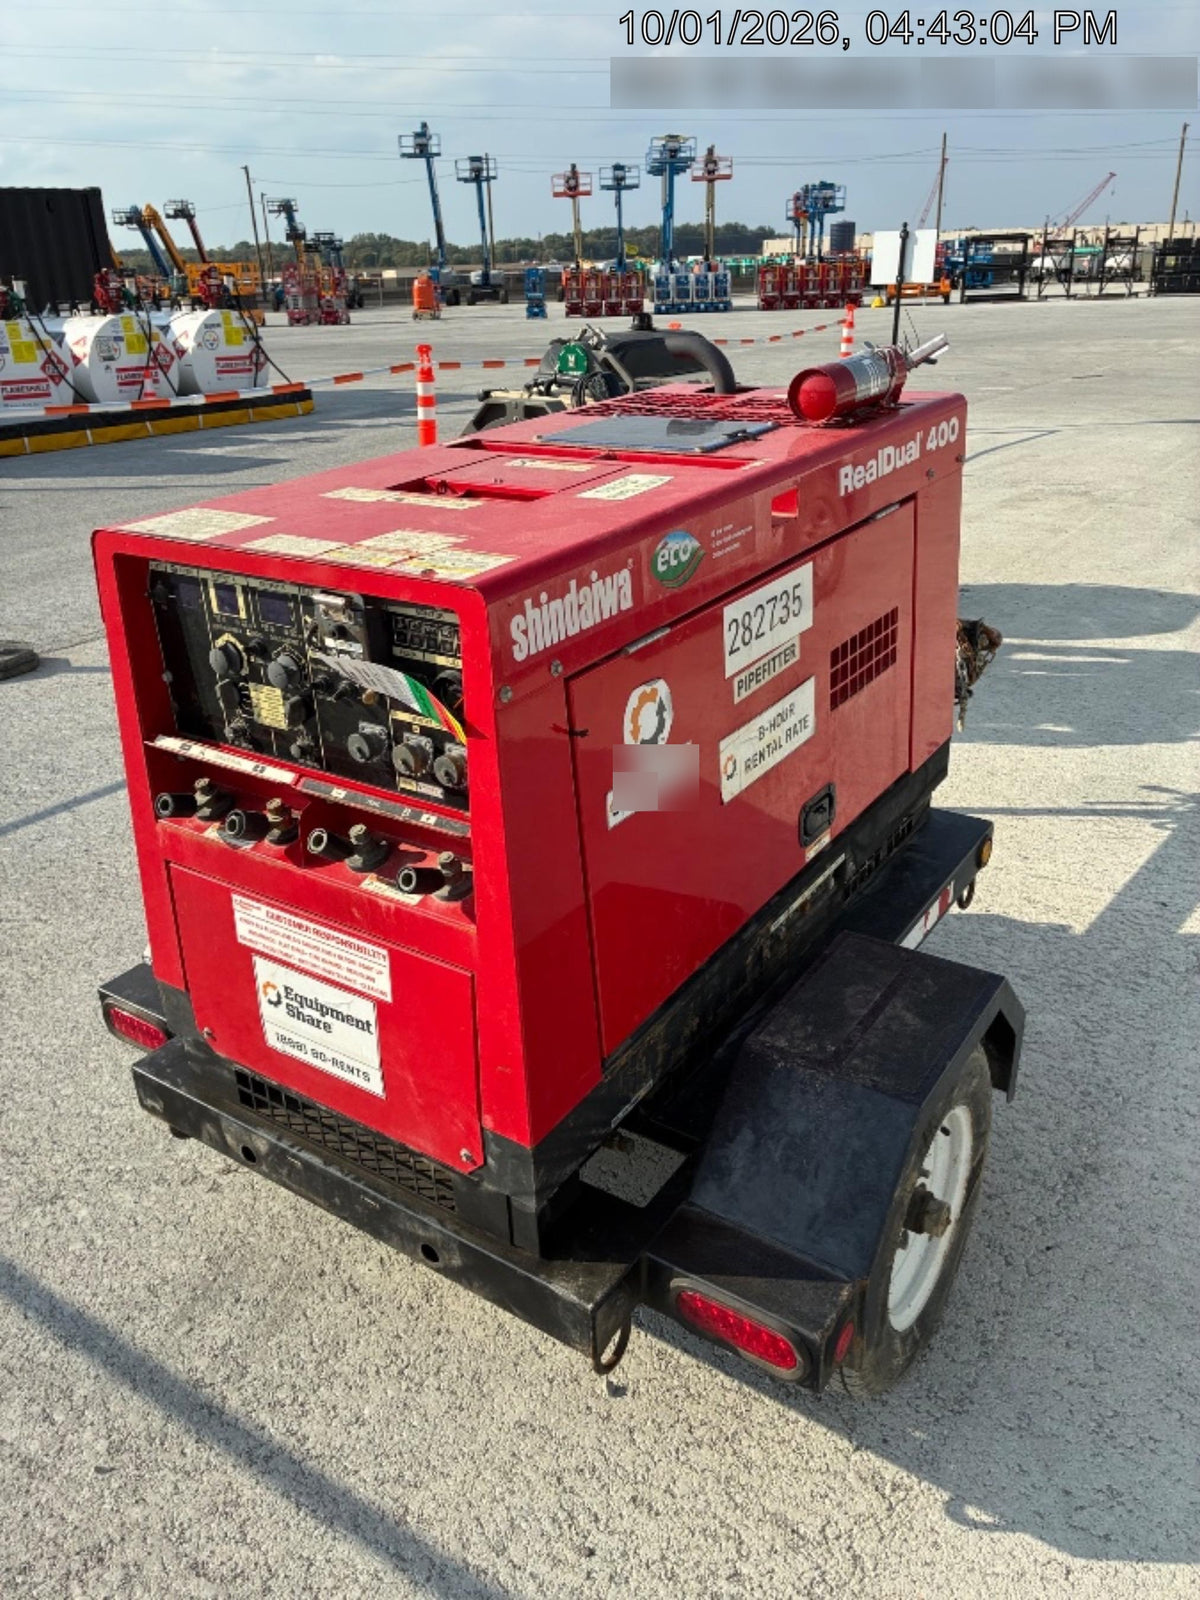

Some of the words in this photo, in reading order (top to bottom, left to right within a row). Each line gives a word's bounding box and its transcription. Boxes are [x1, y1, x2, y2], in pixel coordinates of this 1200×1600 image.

[838, 432, 920, 496] RealDual
[926, 416, 960, 451] 400
[656, 534, 693, 572] eco
[509, 567, 634, 662] shindaiwa
[727, 583, 802, 657] 282735
[736, 643, 797, 698] PIPEFITTER
[743, 738, 783, 775] RENTAL
[785, 714, 811, 744] RATE
[282, 984, 374, 1036] Equipment
[285, 1003, 333, 1034] Share
